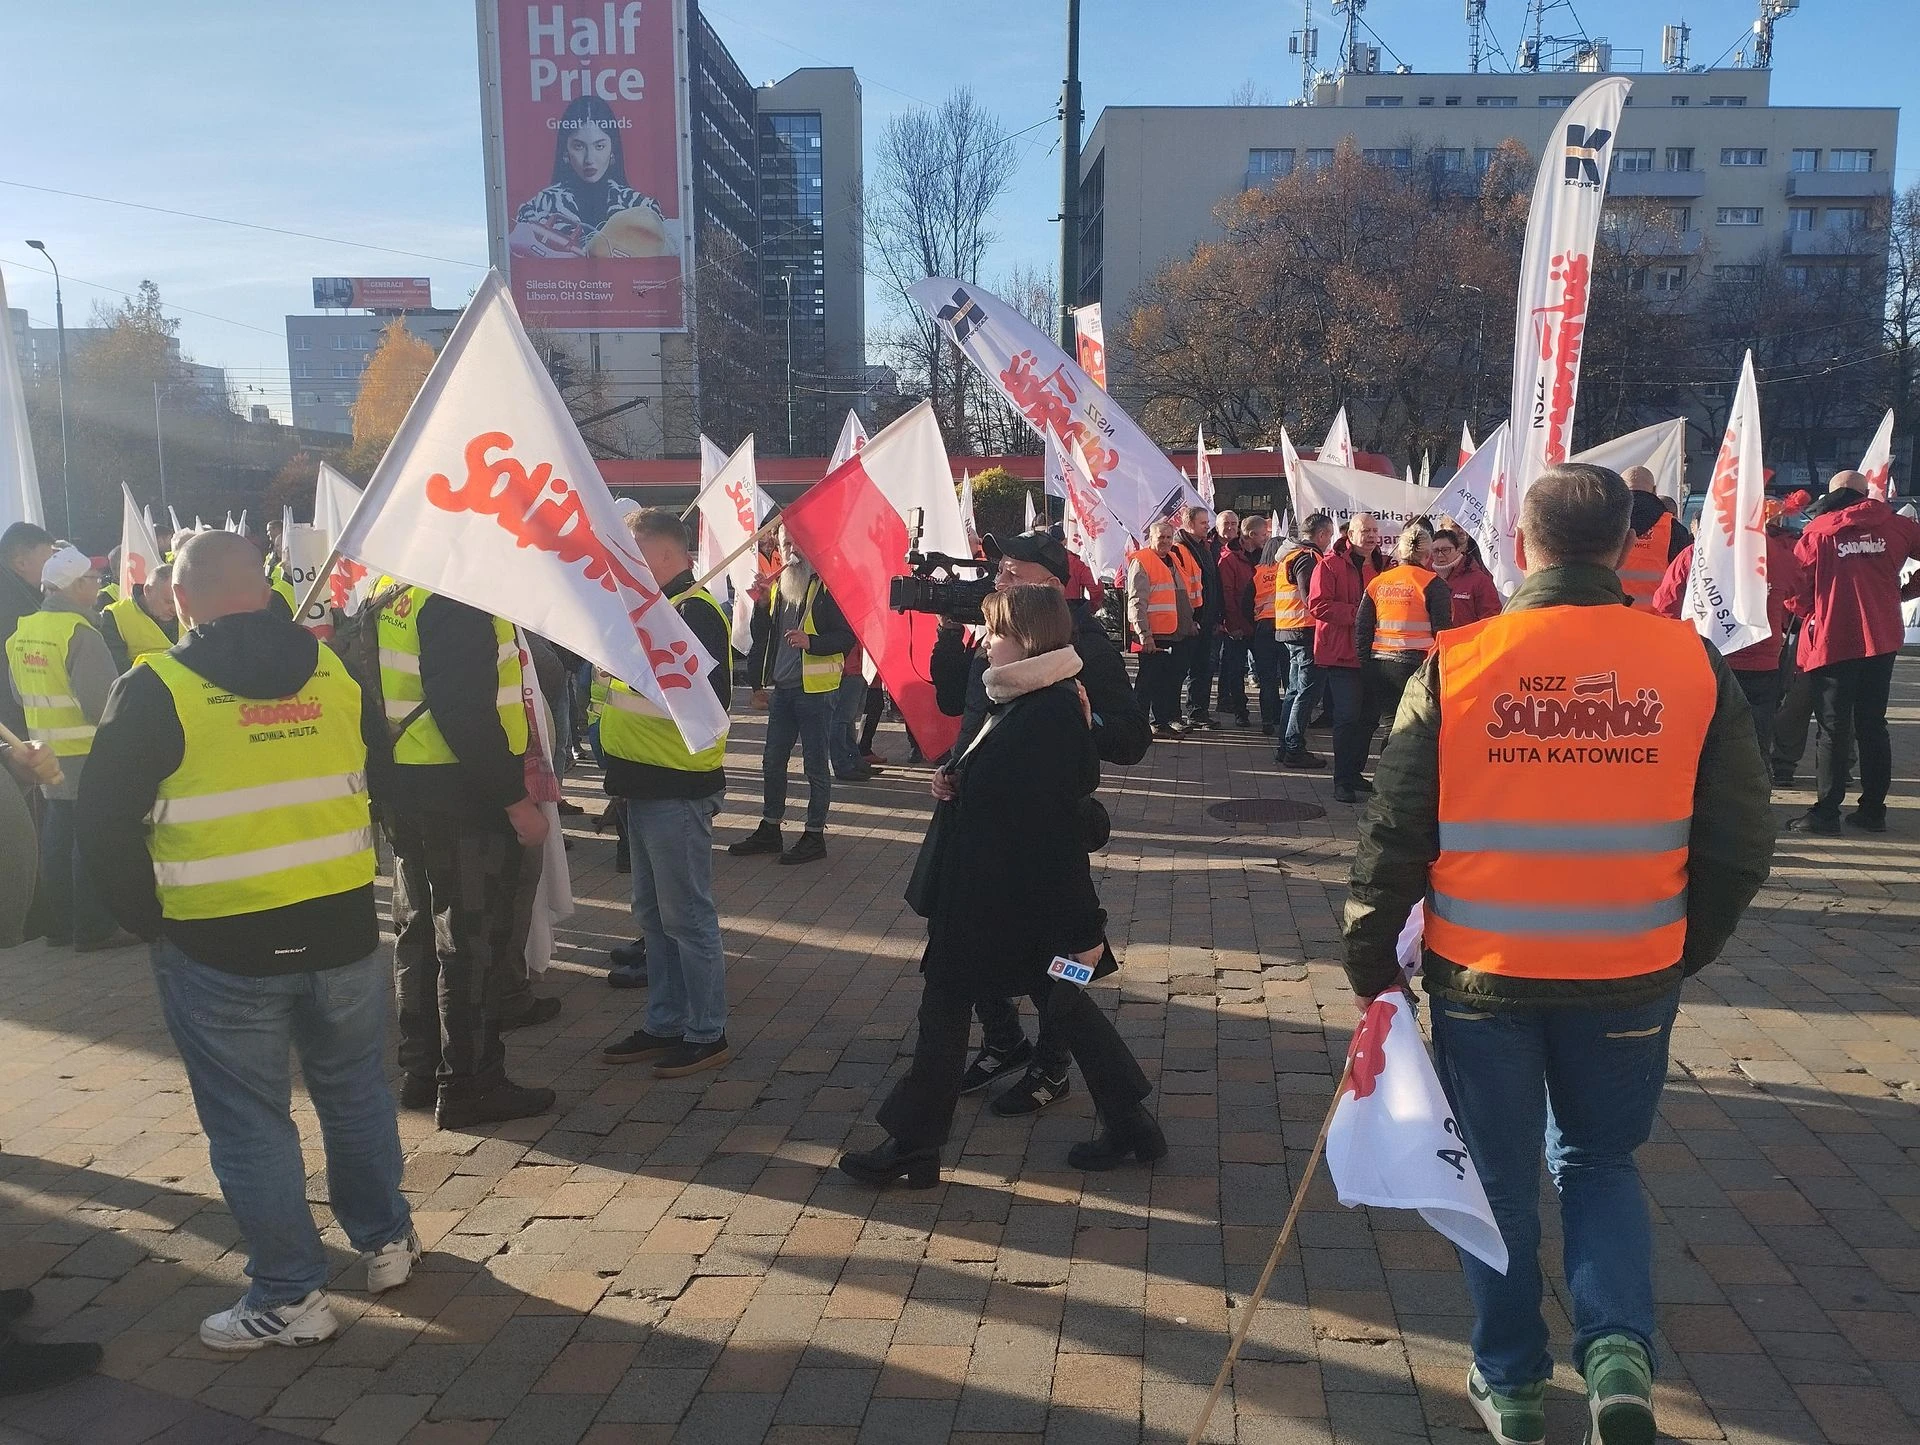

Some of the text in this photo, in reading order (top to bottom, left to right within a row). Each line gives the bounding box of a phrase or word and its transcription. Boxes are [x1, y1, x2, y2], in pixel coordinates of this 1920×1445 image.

[528, 2, 642, 56] Half
[530, 59, 645, 102] Price
[546, 116, 633, 130] Great brands
[526, 280, 613, 291] Silesia City Center
[526, 292, 614, 302] Libero, CH 3 Stawy
[1716, 608, 1737, 638] S.A.
[1519, 676, 1567, 692] NSZZ
[1486, 684, 1665, 742] SOLIDARNOŚĆ
[287, 725, 319, 739] HUTA
[1487, 747, 1659, 764] HUTA KATOWICE
[1052, 961, 1090, 981] TVS
